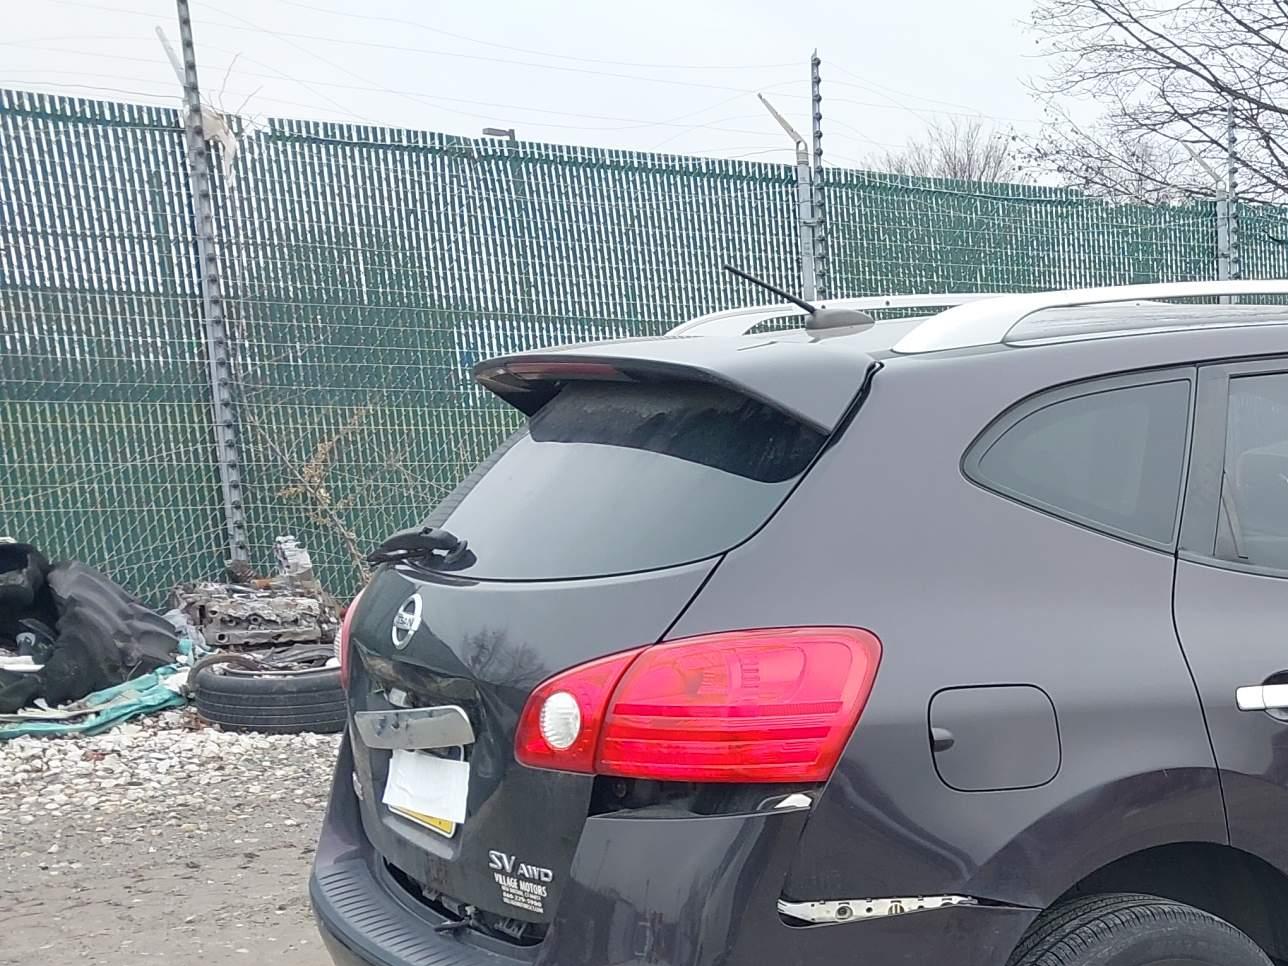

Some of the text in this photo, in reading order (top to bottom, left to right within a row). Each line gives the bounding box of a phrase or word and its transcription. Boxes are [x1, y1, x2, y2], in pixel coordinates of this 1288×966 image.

[488, 850, 553, 882] SV AWD
[494, 872, 519, 889] VILLAGE
[519, 879, 547, 897] MOTORS
